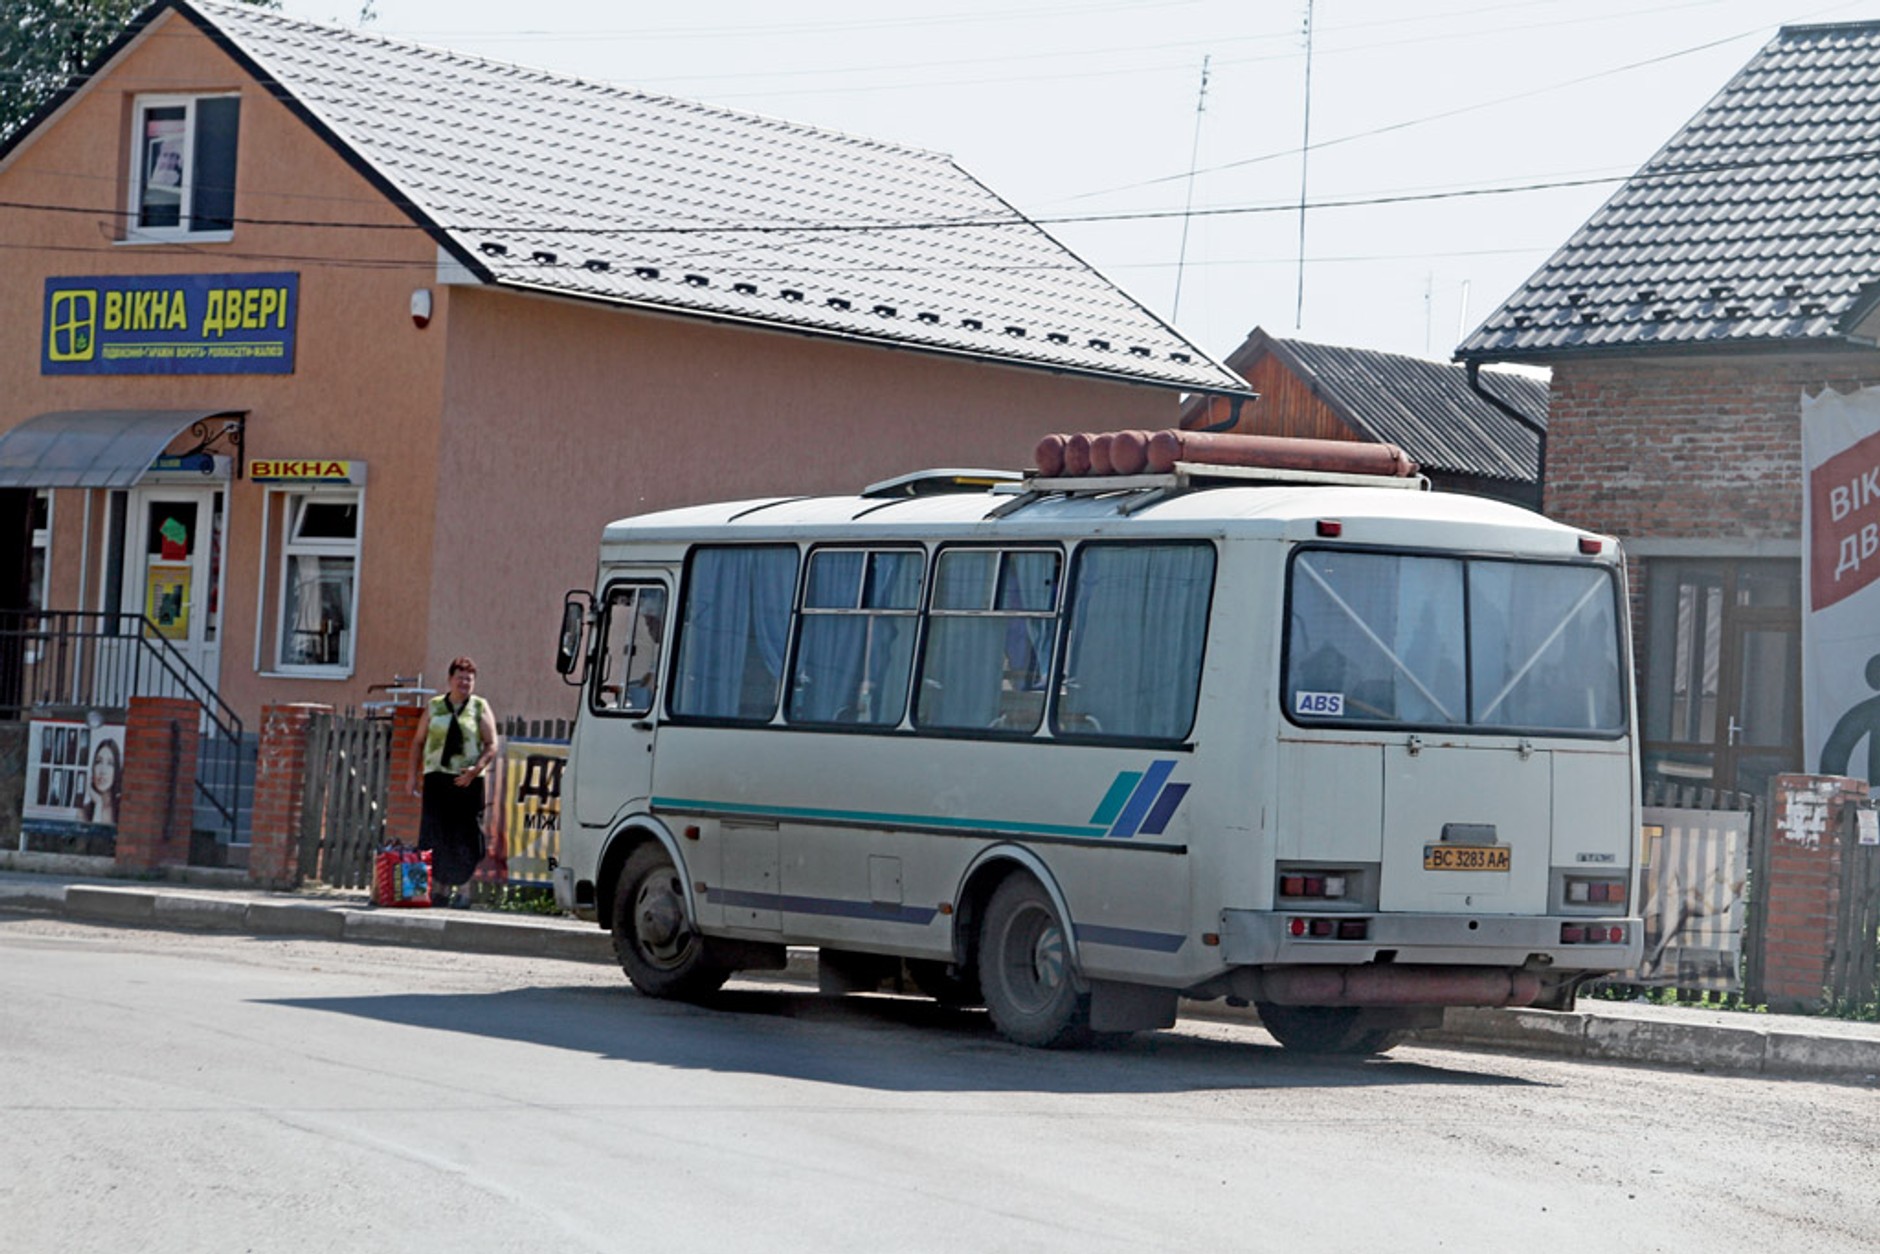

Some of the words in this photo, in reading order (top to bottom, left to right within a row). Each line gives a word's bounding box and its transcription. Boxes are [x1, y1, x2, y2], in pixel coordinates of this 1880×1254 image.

[104, 290, 188, 331] ВІКНА
[202, 288, 288, 338] ДВЕРІ
[251, 461, 345, 476] ВІКНА
[1831, 466, 1880, 522] ВІК
[1299, 694, 1341, 713] ABS
[1455, 850, 1485, 868] 3283
